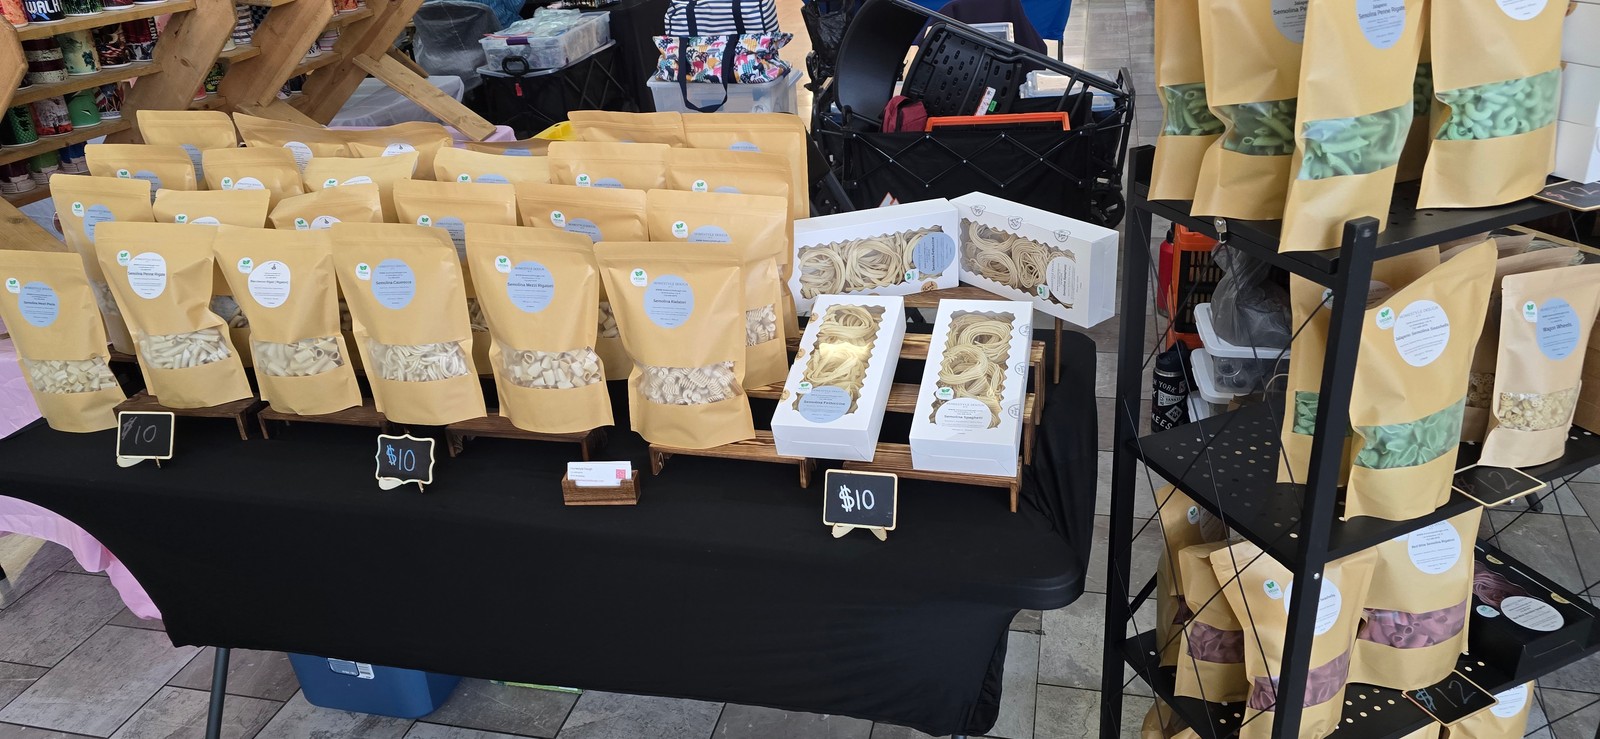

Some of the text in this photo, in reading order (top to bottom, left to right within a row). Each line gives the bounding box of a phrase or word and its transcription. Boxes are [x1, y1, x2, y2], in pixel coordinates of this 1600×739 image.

[1273, 7, 1299, 15] Semolina
[1358, 11, 1377, 20] Semolina
[121, 416, 157, 445] $10
[385, 444, 416, 472] $10
[838, 484, 875, 513] $10
[1415, 680, 1477, 712] $12
